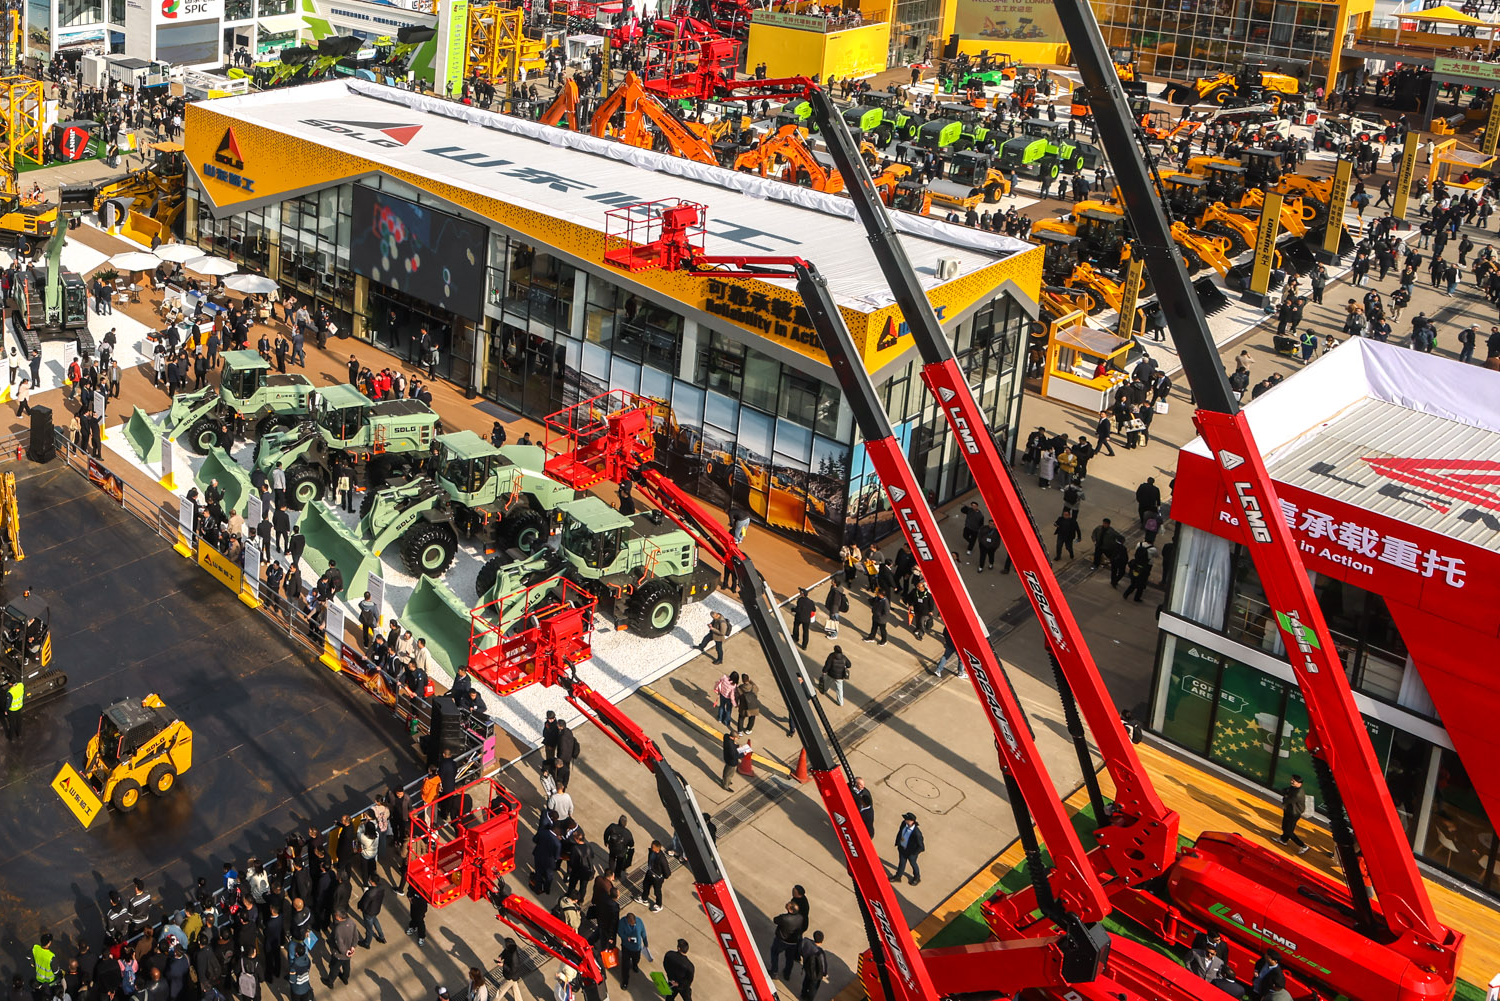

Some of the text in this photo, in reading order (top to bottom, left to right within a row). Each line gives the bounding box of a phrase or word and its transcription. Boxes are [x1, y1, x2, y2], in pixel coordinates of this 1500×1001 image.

[185, 3, 208, 14] SPIC
[297, 119, 406, 149] SDLG
[1262, 216, 1274, 254] LONKING
[183, 414, 198, 427] SDLG
[394, 426, 417, 434] SDLG
[396, 513, 416, 531] SDLG
[1300, 541, 1374, 575] in Action
[145, 737, 166, 754] SDLG
